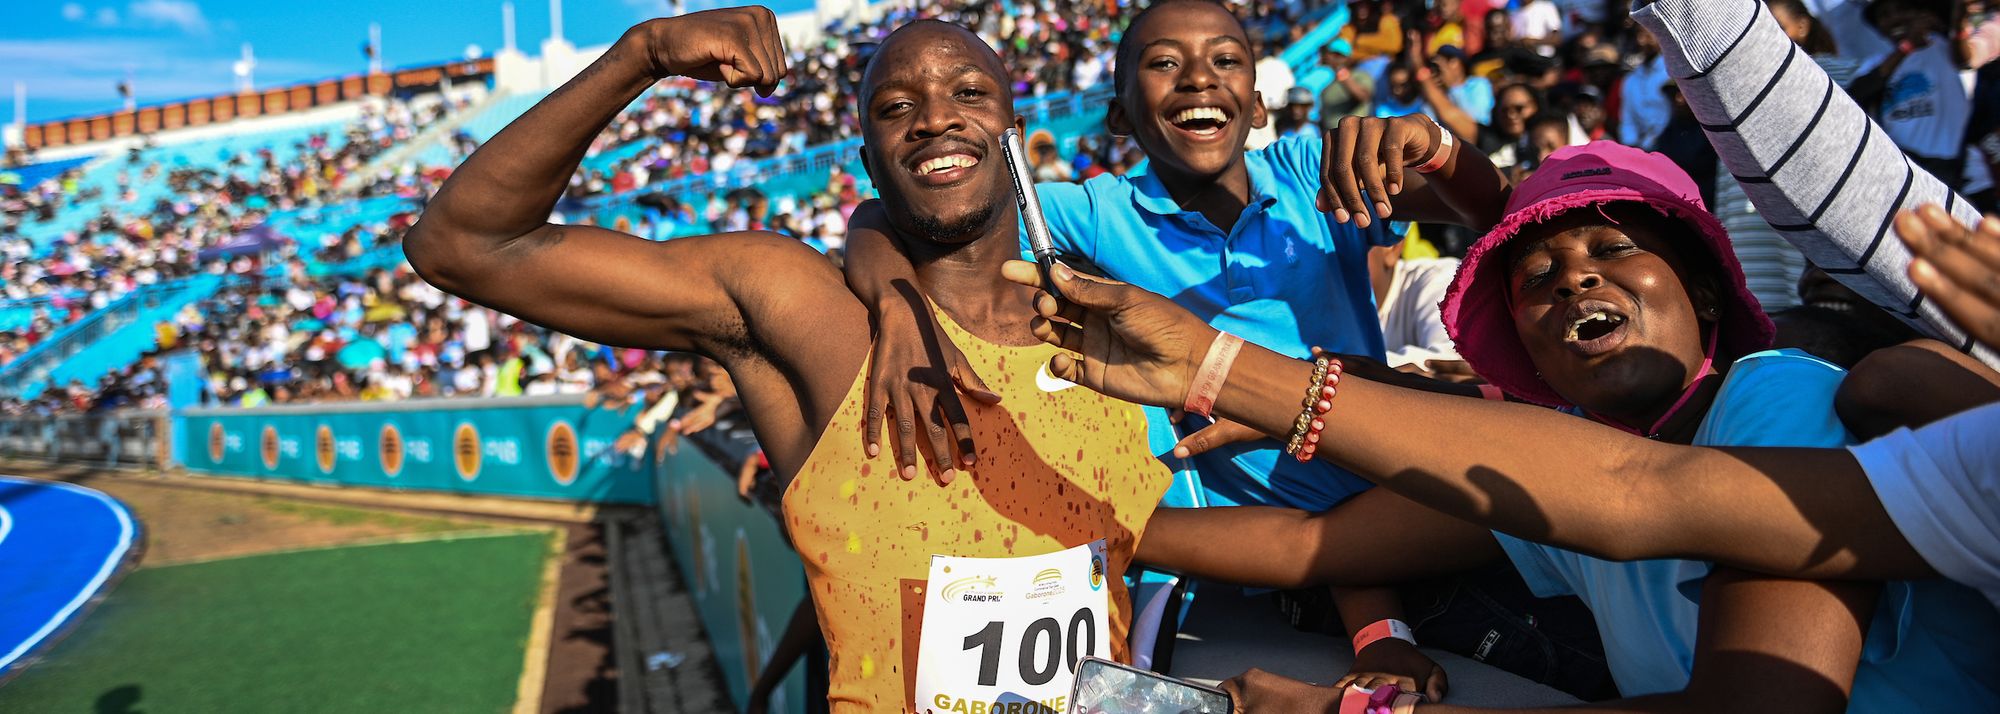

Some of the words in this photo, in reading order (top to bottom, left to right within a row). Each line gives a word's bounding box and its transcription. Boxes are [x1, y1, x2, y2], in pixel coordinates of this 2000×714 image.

[963, 594, 986, 602] GRAND
[963, 607, 1096, 686] 100
[934, 693, 1066, 714] GABORONE
